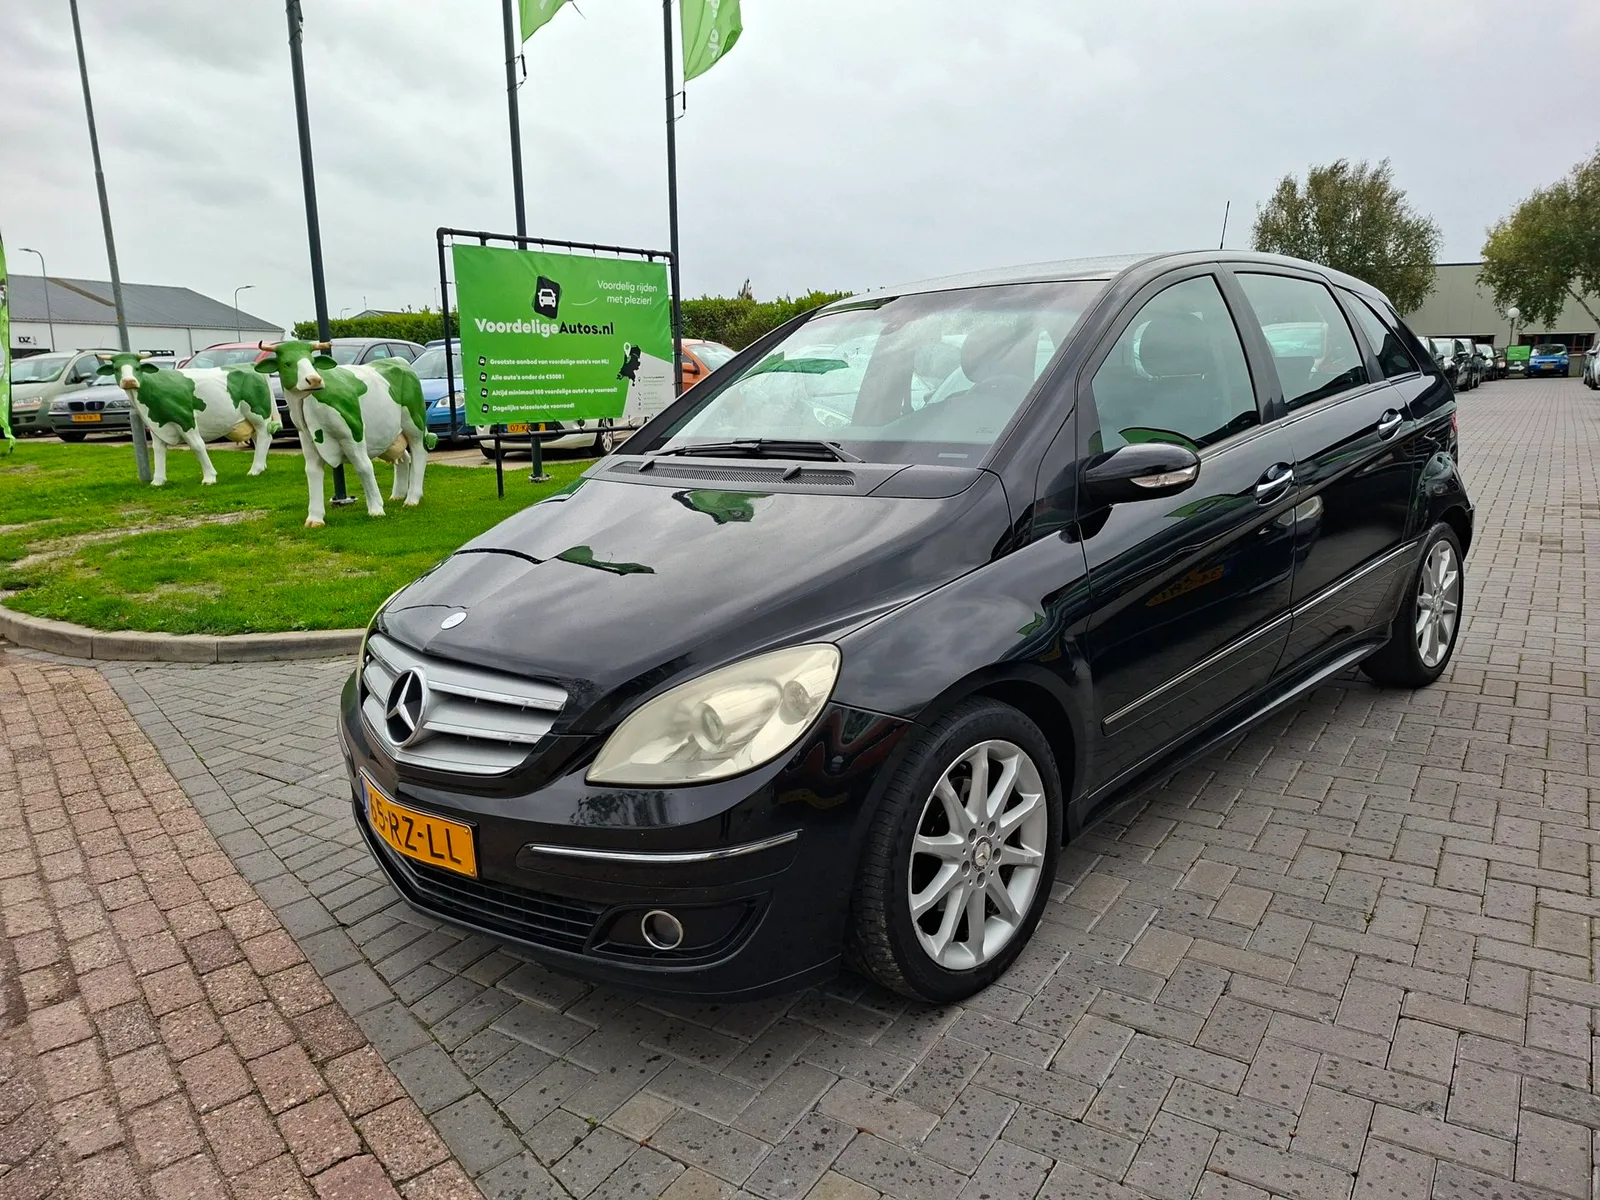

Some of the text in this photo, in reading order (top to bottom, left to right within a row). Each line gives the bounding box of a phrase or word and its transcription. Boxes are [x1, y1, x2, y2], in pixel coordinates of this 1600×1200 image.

[597, 280, 658, 294] Voordelig rijden
[606, 295, 652, 306] met plezier!
[475, 318, 614, 338] VoordeligeAutos.nl
[493, 404, 519, 412] Dagelijks
[369, 793, 462, 866] 65-RZ-LL
